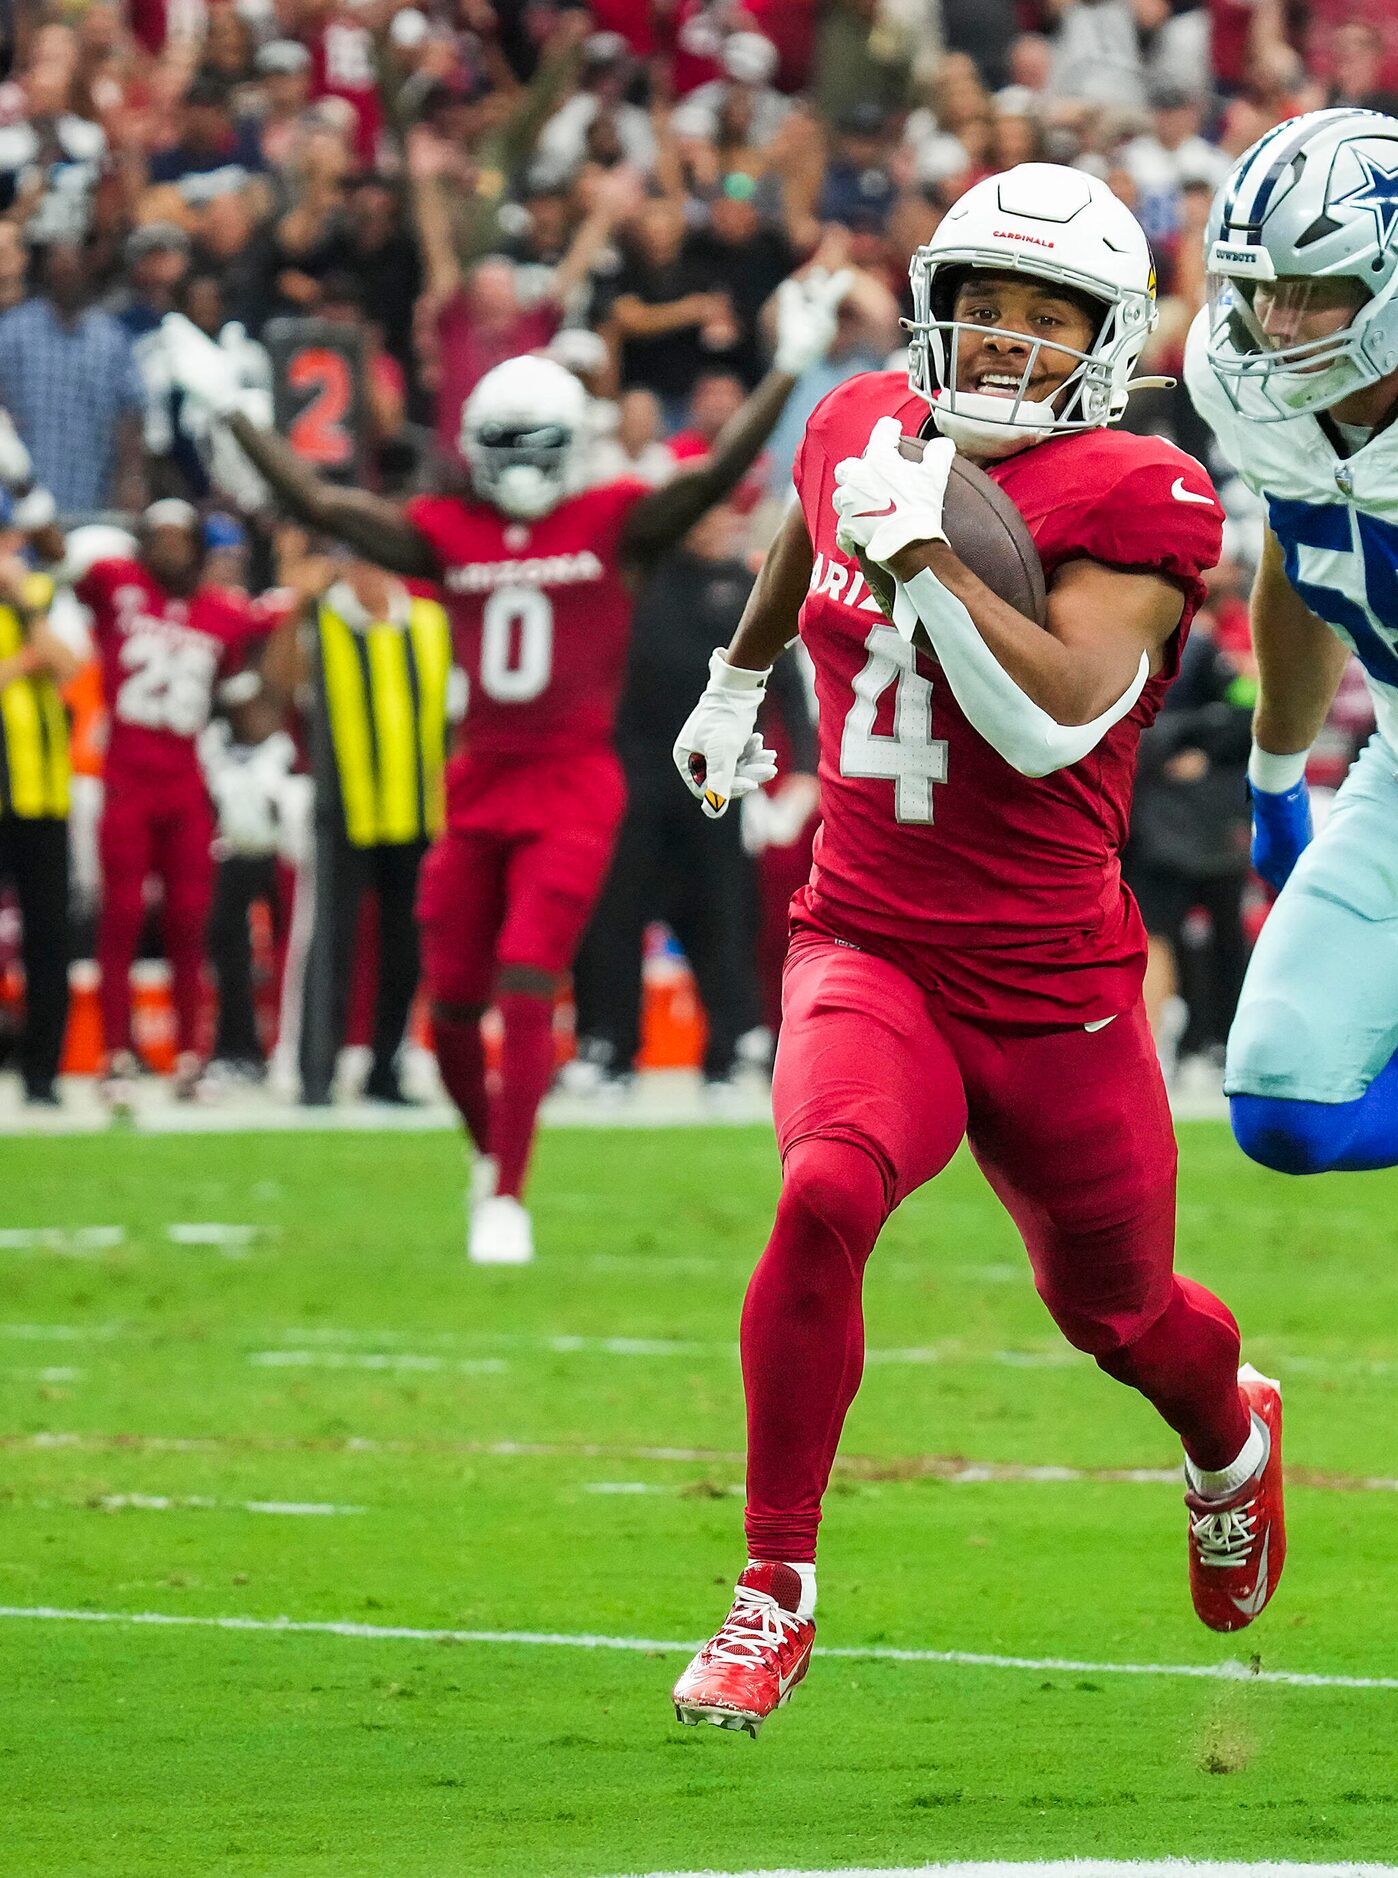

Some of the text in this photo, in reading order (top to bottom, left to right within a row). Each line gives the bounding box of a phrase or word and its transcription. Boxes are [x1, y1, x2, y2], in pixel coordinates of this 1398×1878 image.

[992, 231, 1055, 249] CARDINALS
[1216, 248, 1257, 263] COWBOYS
[287, 347, 354, 466] 2
[481, 583, 555, 702] 0
[840, 623, 949, 826] 4
